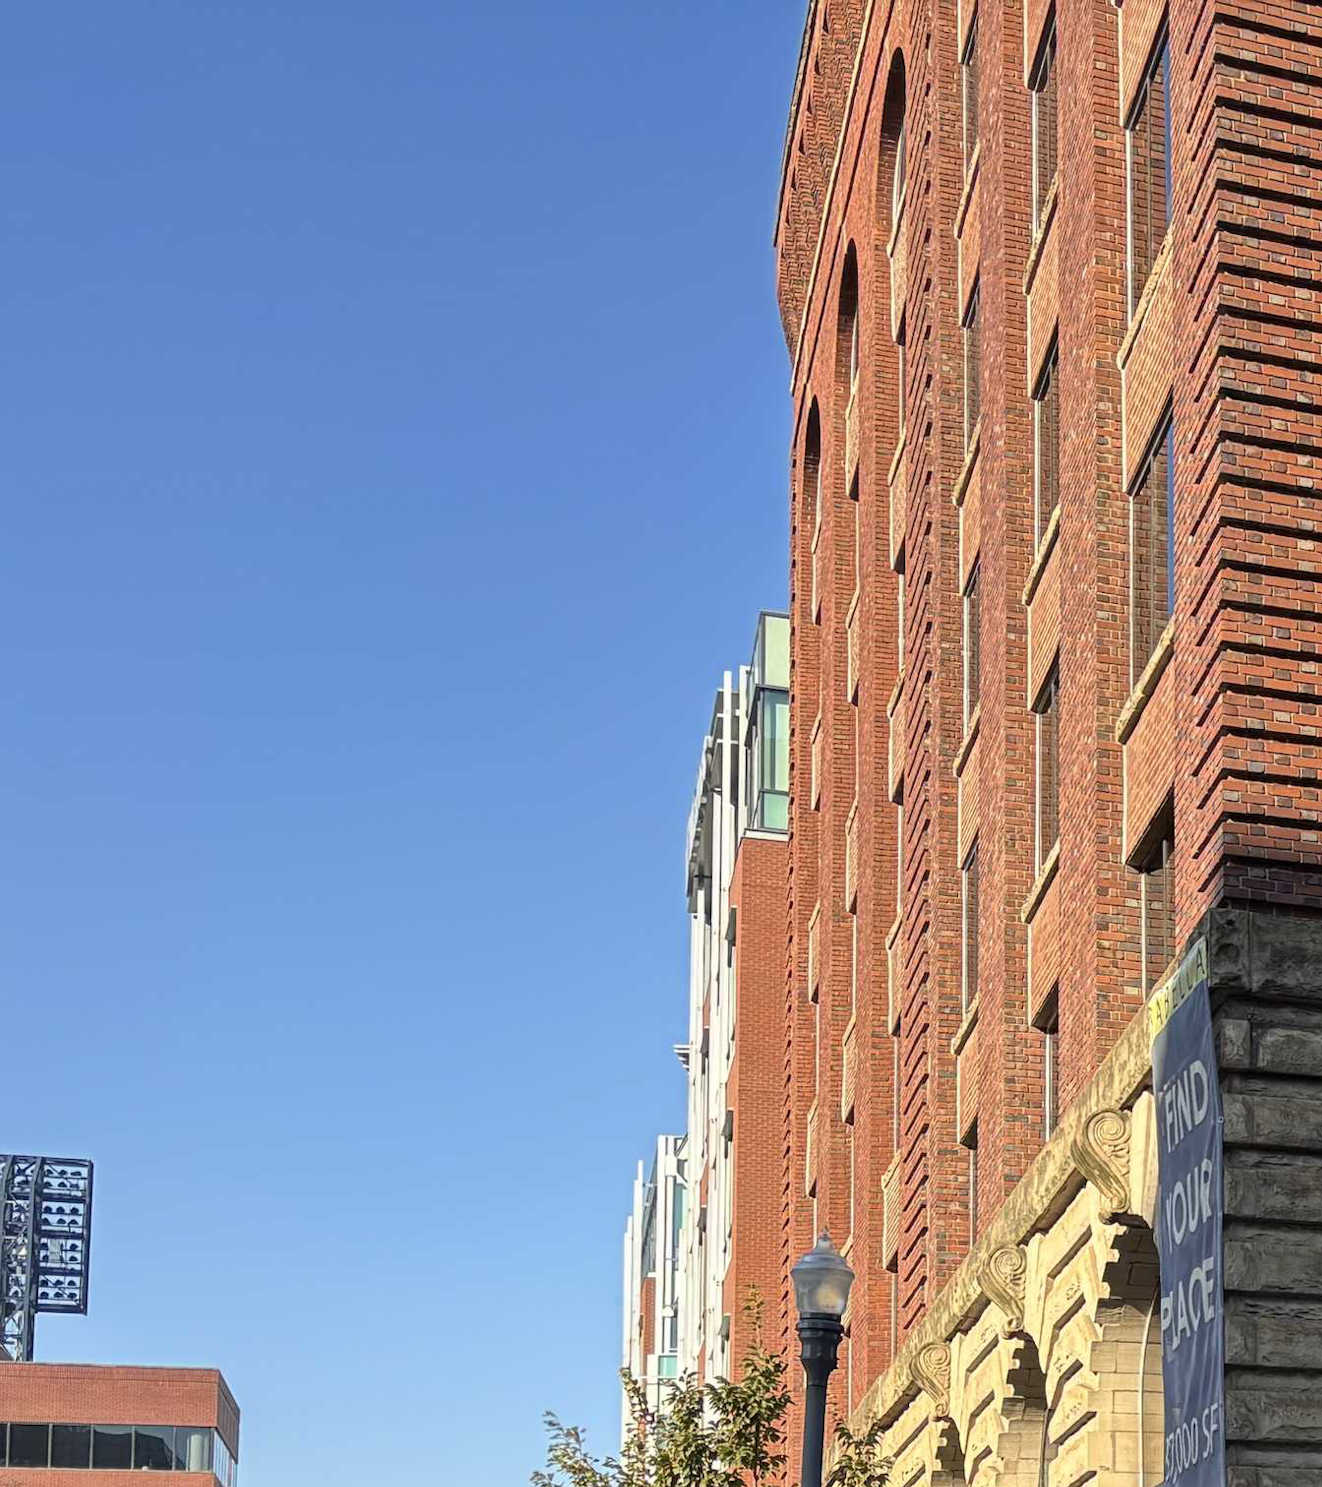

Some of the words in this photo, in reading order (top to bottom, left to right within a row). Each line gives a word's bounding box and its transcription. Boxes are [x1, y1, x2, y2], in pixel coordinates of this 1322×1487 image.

[1165, 1060, 1209, 1154] FIND
[1166, 1158, 1213, 1254] YOUR
[1161, 1256, 1215, 1350] PLACE
[1201, 1402, 1218, 1459] SF
